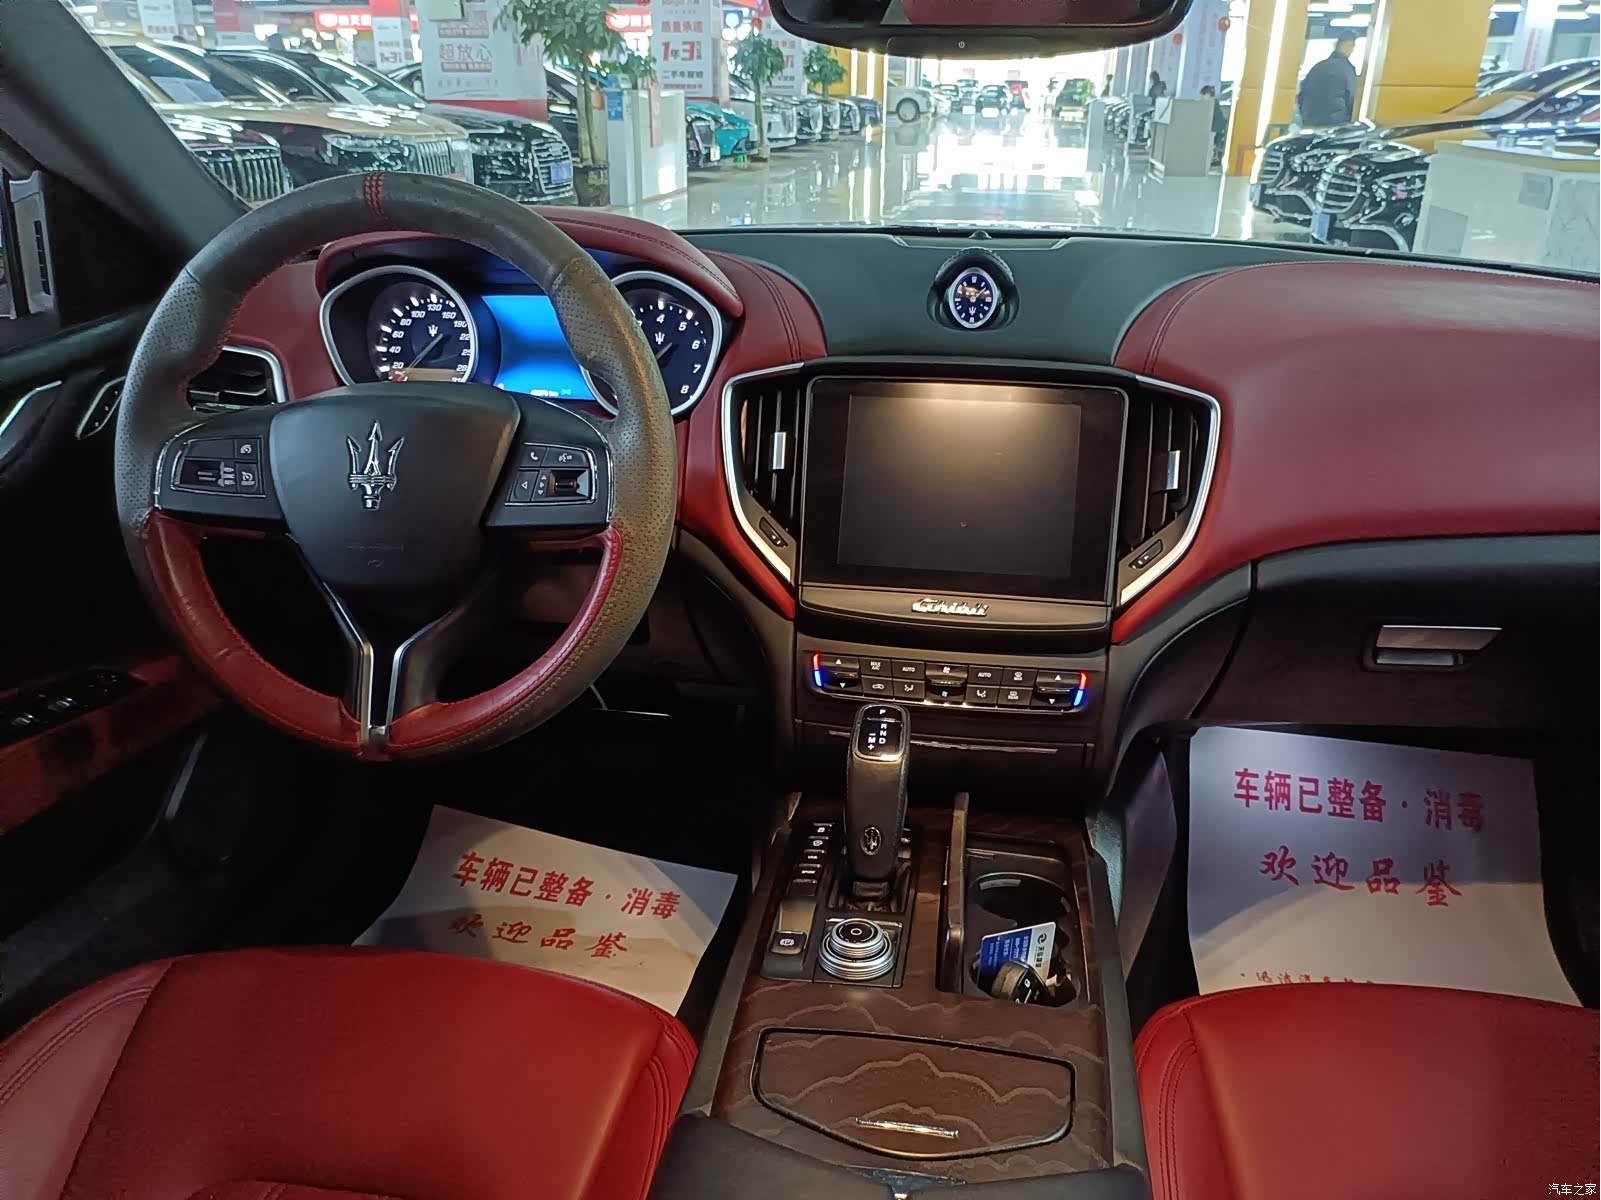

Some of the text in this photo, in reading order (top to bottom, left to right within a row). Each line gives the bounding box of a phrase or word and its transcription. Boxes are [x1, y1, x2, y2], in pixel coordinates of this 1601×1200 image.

[439, 43, 493, 62] 超放心
[427, 303, 442, 311] 130
[411, 310, 426, 318] 100
[441, 311, 456, 319] 160
[400, 318, 412, 326] 80
[656, 314, 665, 324] 4
[678, 321, 687, 331] 5
[392, 330, 404, 338] 60
[459, 332, 471, 341] 22
[388, 345, 401, 354] 40
[691, 340, 700, 350] 6
[392, 361, 404, 369] 20
[692, 363, 701, 374] 7
[680, 384, 689, 394] 8
[879, 729, 888, 737] N
[867, 736, 877, 744] M
[878, 737, 887, 745] D
[1233, 767, 1486, 834] 车辆已整备·消毒
[1259, 844, 1463, 907] 欢迎品鉴
[452, 851, 681, 920] 车辆已整备·消毒
[447, 913, 628, 959] 欢迎品鉴
